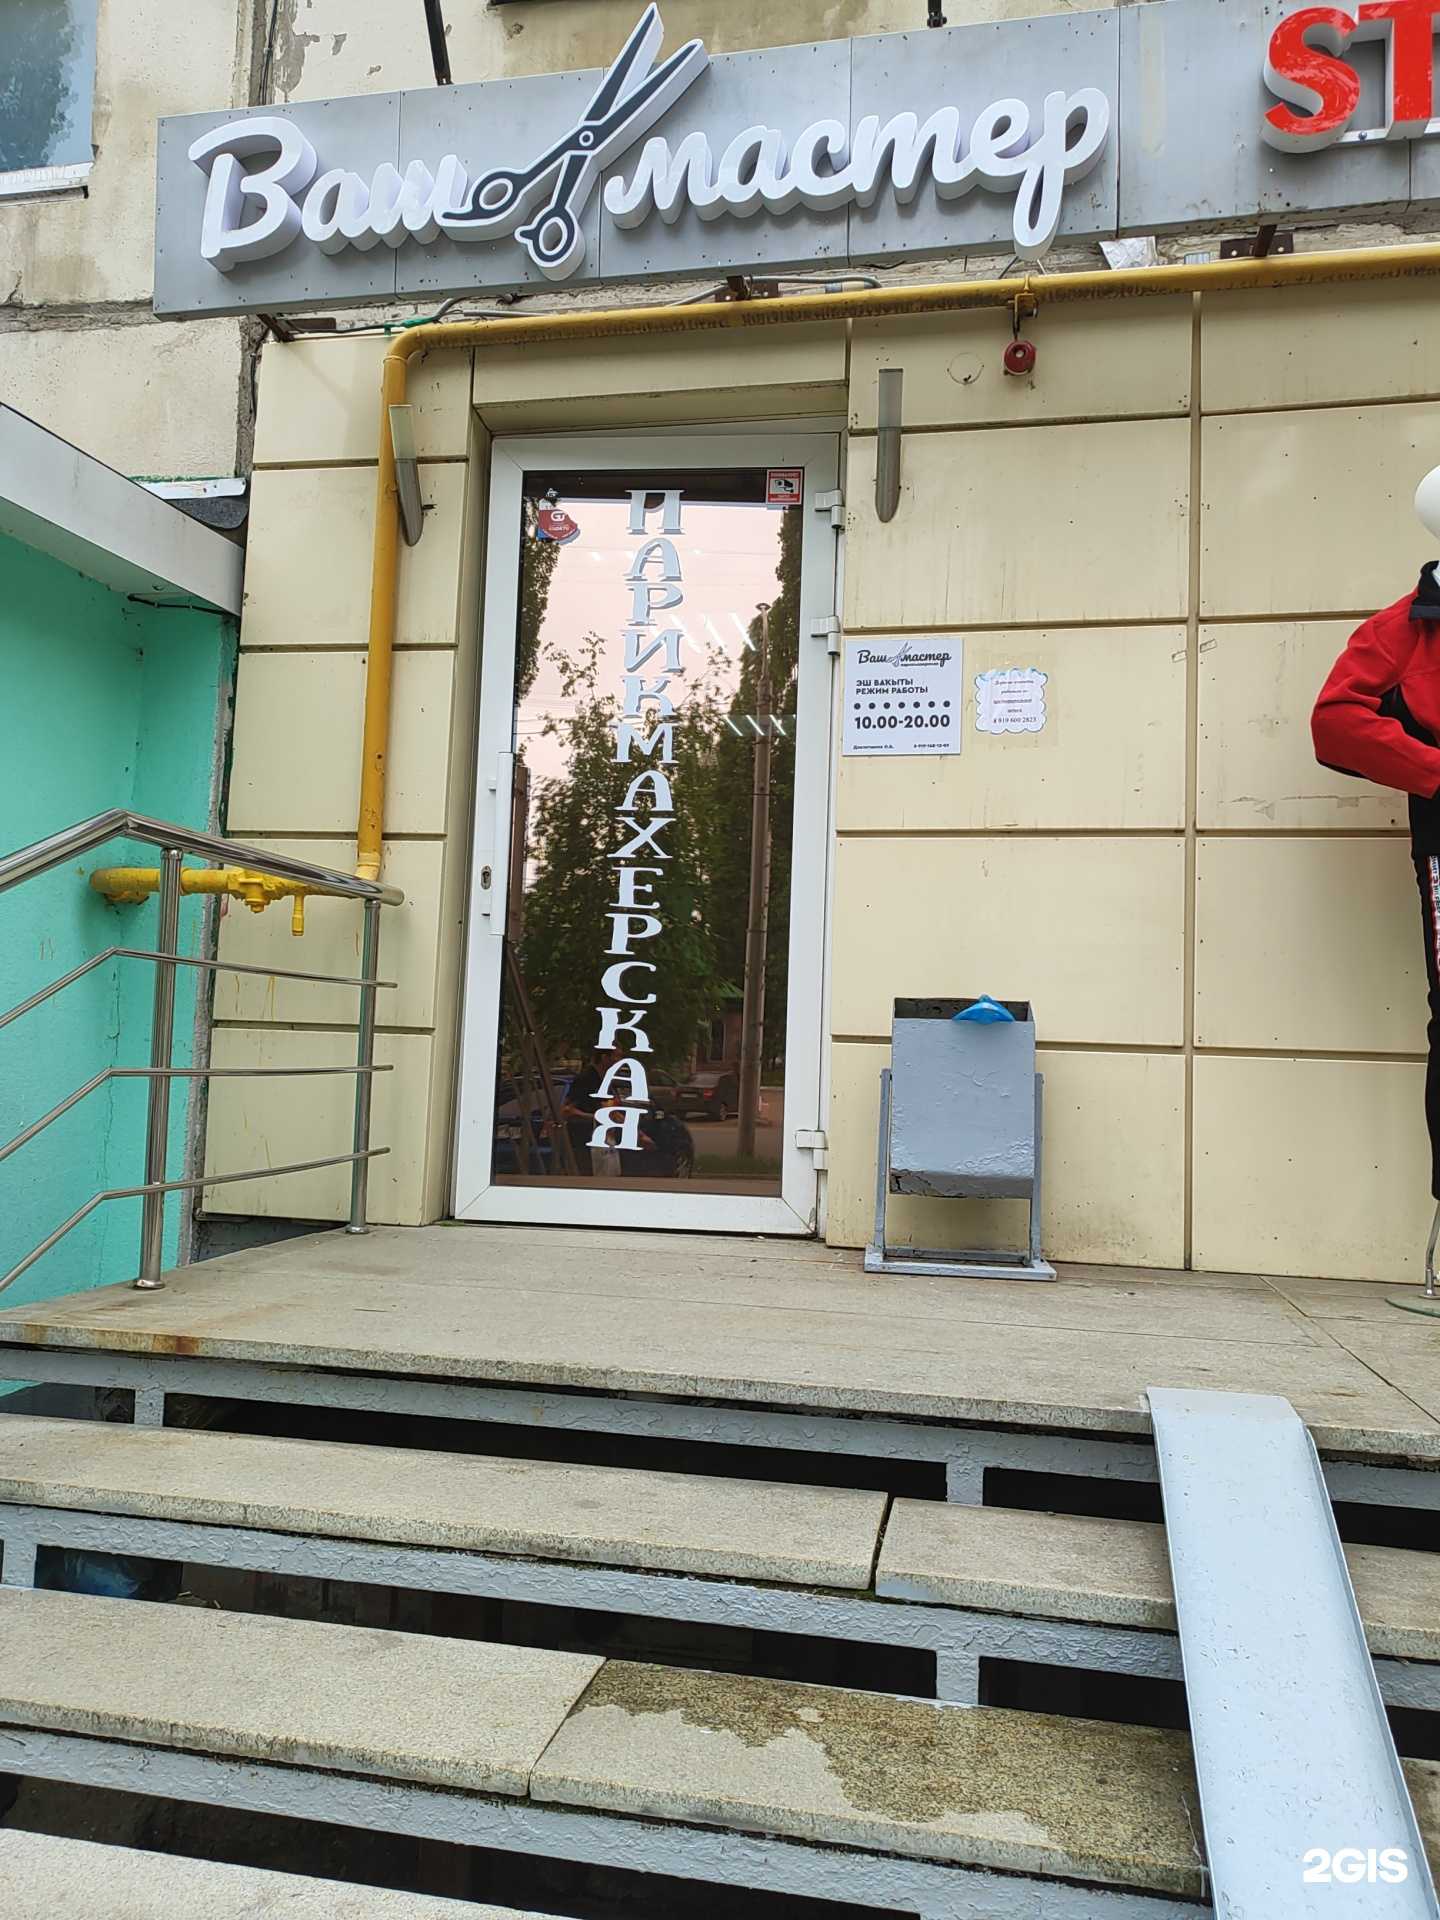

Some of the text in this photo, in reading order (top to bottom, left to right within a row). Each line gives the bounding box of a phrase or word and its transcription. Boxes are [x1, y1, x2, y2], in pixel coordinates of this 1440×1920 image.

[188, 87, 1110, 264] Ваш мастер
[857, 650, 952, 667] Ваш мастер
[891, 686, 928, 694] РАБОТЫ
[855, 714, 950, 729] 10.00-20.00
[586, 489, 686, 1151] ПАРИКМАХЕРСКАЯ
